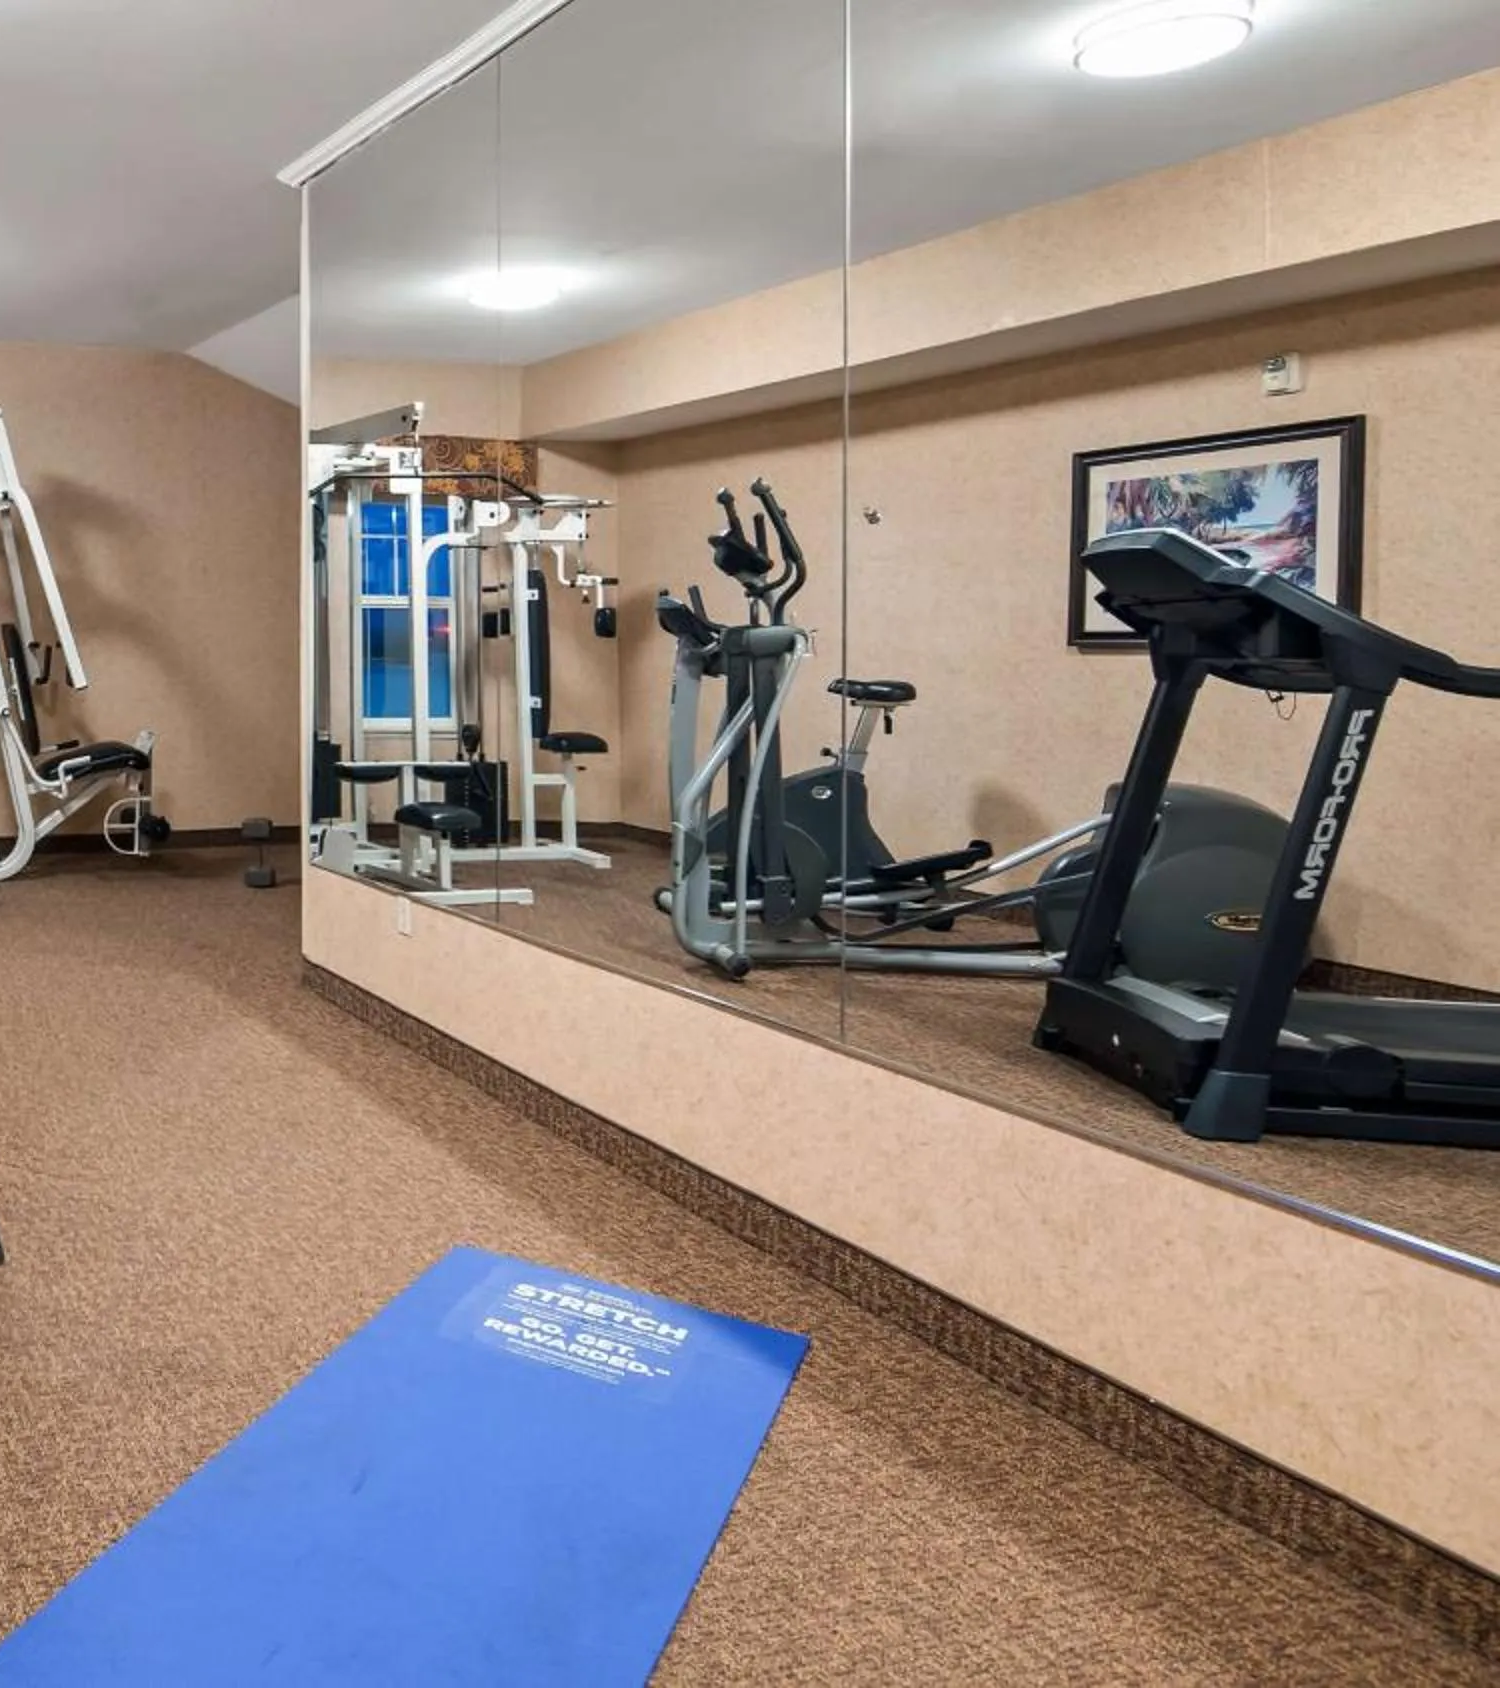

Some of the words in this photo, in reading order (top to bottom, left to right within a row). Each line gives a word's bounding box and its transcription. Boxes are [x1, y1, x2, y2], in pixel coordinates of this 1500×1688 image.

[512, 1283, 689, 1341] STRETCH
[521, 1316, 567, 1338] GO.
[575, 1333, 636, 1358] GET.
